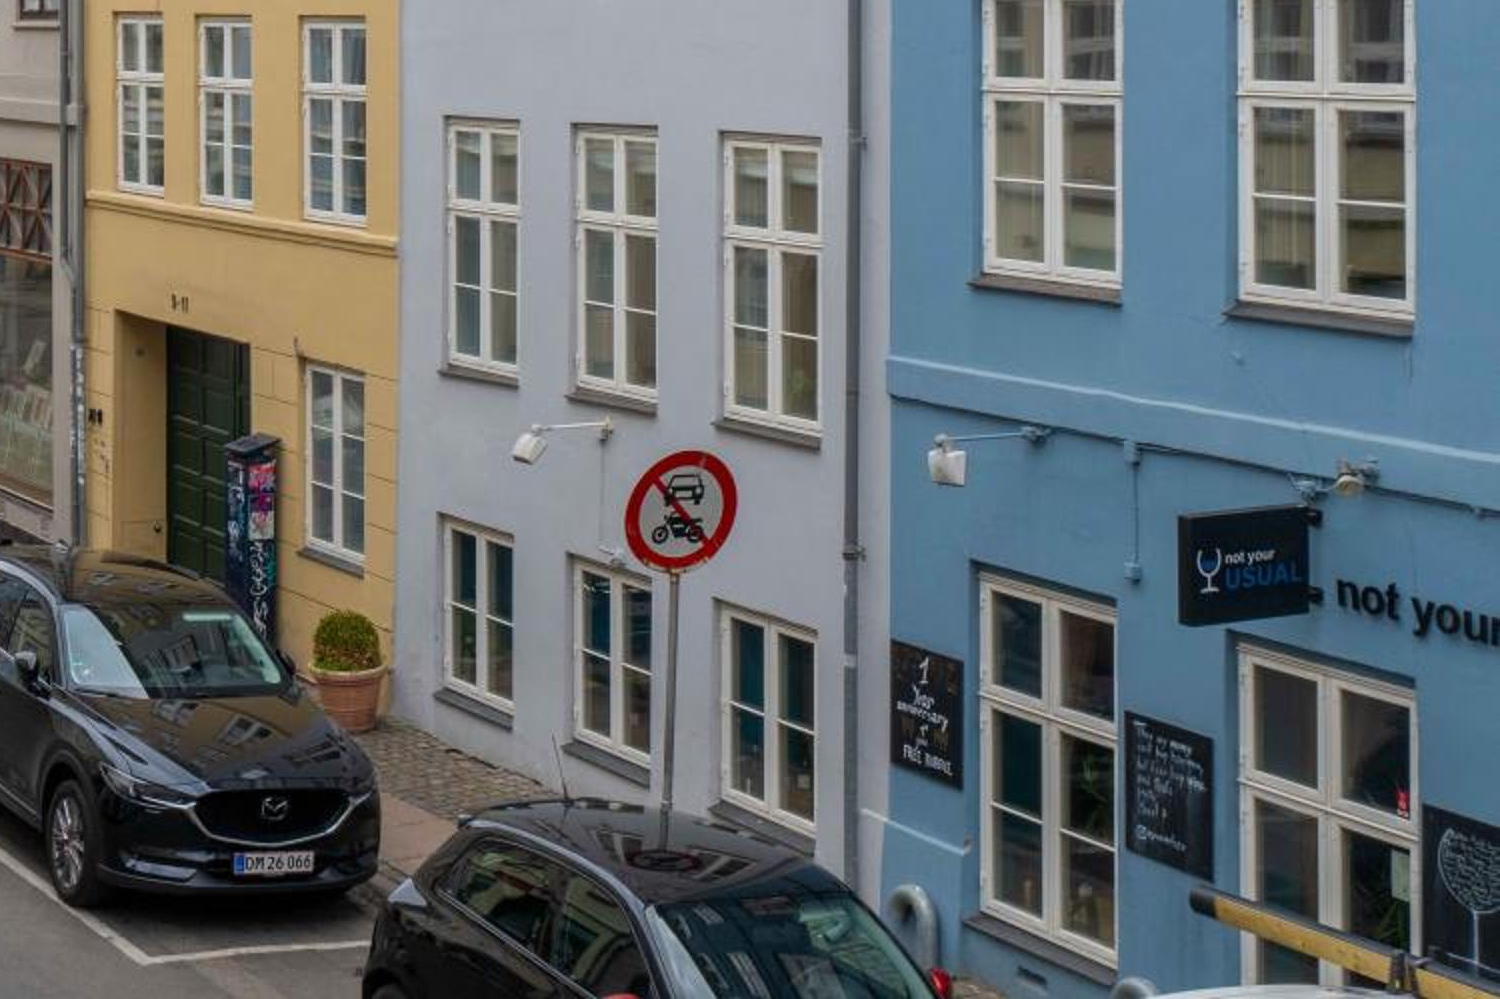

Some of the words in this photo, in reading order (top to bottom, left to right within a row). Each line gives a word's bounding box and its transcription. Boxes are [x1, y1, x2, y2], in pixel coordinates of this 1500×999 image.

[1225, 552, 1245, 564] not
[1247, 550, 1276, 566] your
[1225, 562, 1301, 589] USUAL
[1336, 579, 1400, 622] not
[245, 856, 265, 871] DM
[267, 856, 285, 870] 26
[287, 855, 311, 870] 066
